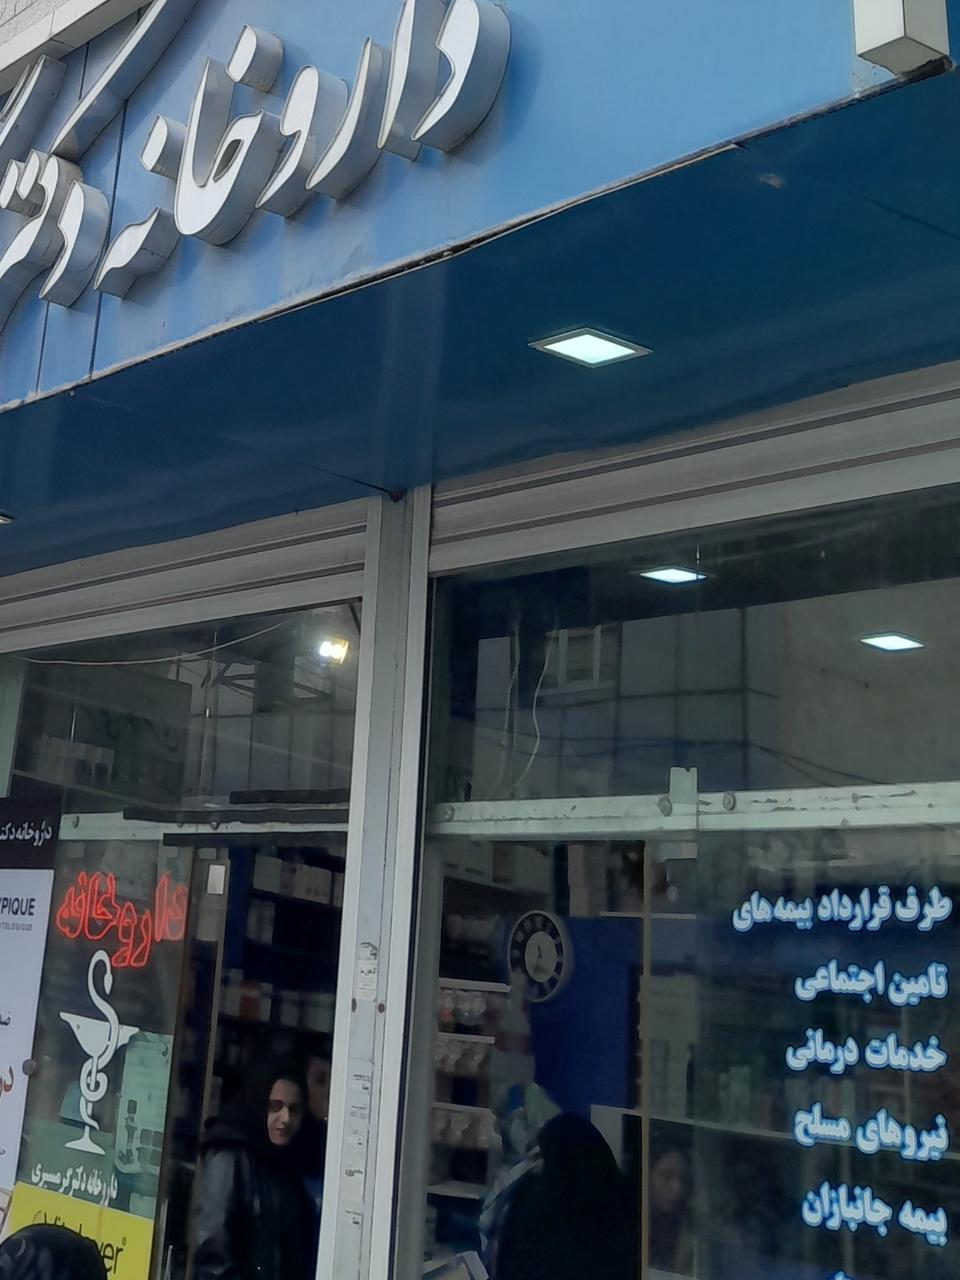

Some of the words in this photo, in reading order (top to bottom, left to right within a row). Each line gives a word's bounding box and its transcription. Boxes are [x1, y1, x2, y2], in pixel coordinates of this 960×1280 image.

[56, 871, 188, 967] داروخانه
[817, 884, 892, 932] قرارداد
[895, 885, 953, 932] طرف
[794, 958, 886, 1003] اجتماعی
[888, 960, 949, 1006] تامین
[785, 1027, 860, 1074] درمانی
[865, 1032, 948, 1074] خدمات
[793, 1101, 852, 1147] مسلح
[856, 1107, 950, 1162] نیروهای
[68, 1165, 86, 1197] دکتر
[87, 1169, 118, 1207] داروخانه
[801, 1180, 894, 1236] جانبازان
[899, 1198, 949, 1247] بیمه
